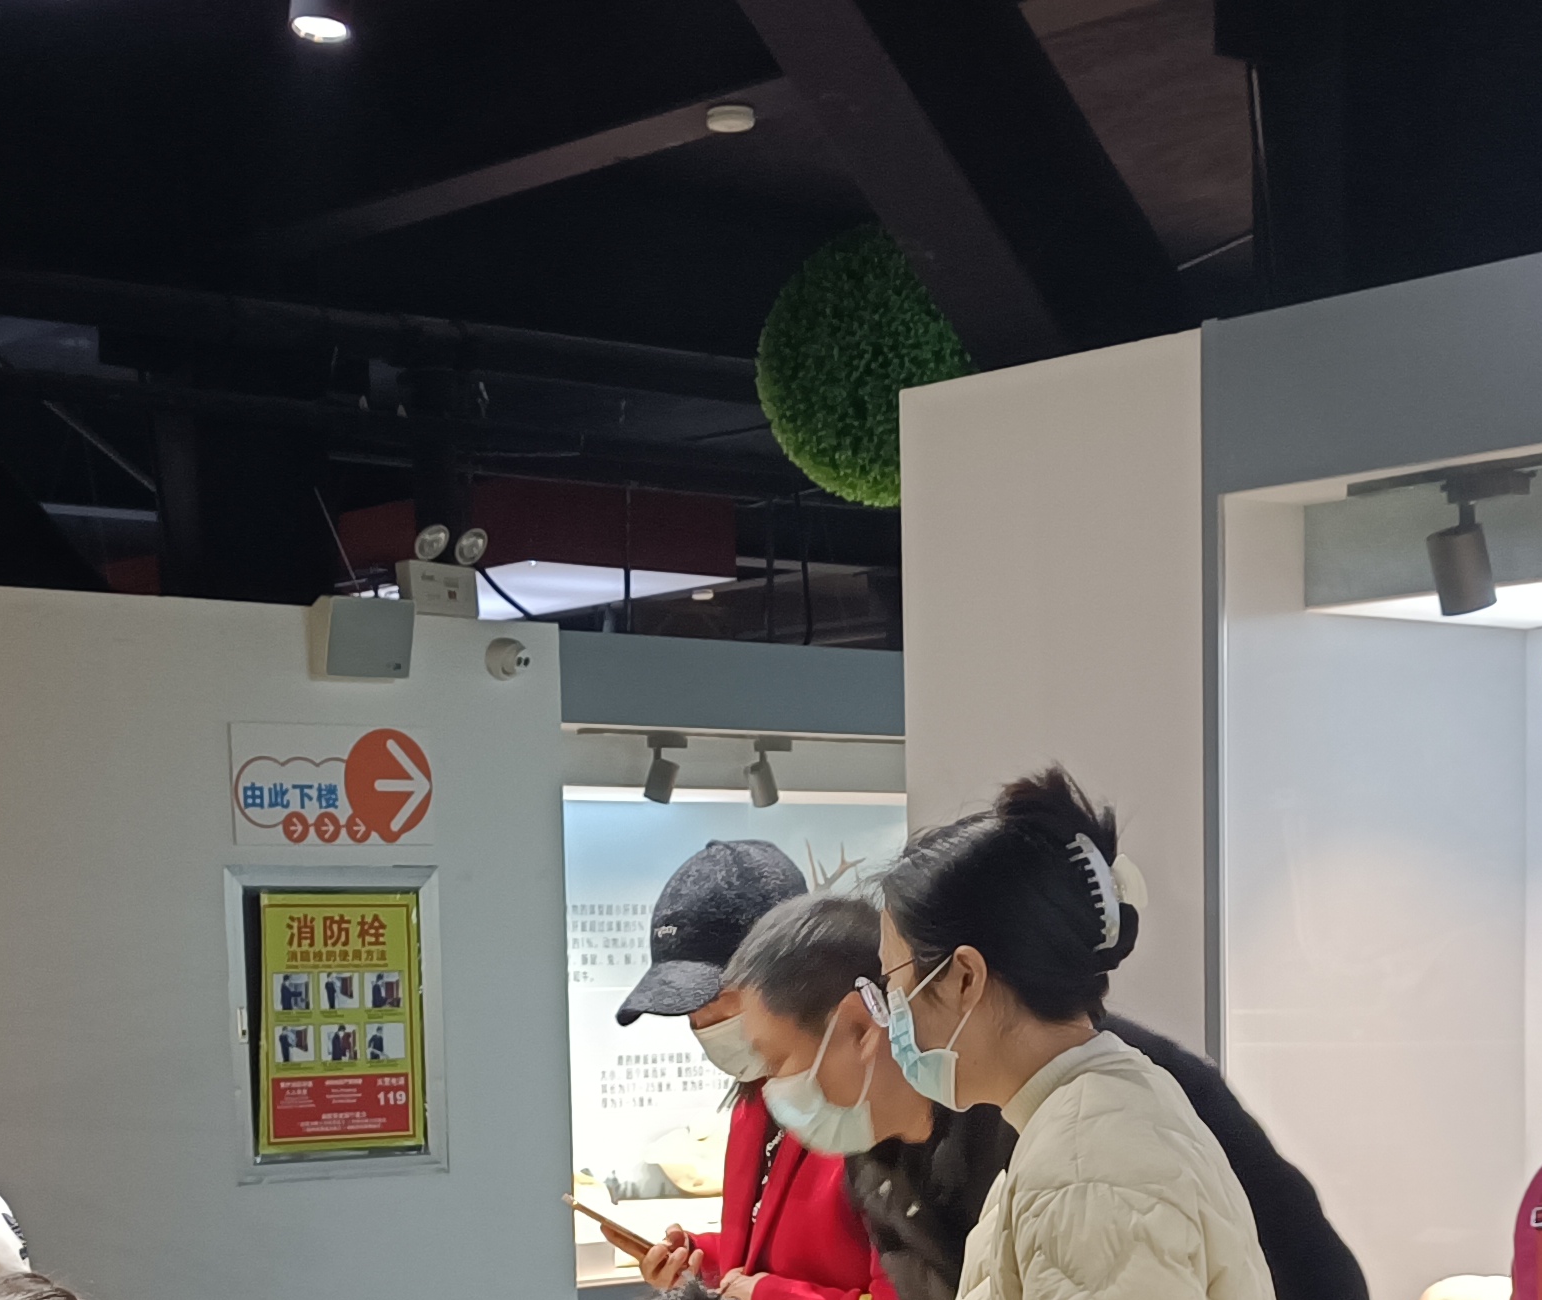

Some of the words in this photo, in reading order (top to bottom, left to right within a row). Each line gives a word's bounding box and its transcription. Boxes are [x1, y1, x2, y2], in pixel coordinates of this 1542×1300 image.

[242, 782, 339, 811] 由此下楼
[286, 913, 387, 949] 消防栓
[377, 1090, 406, 1106] 119
